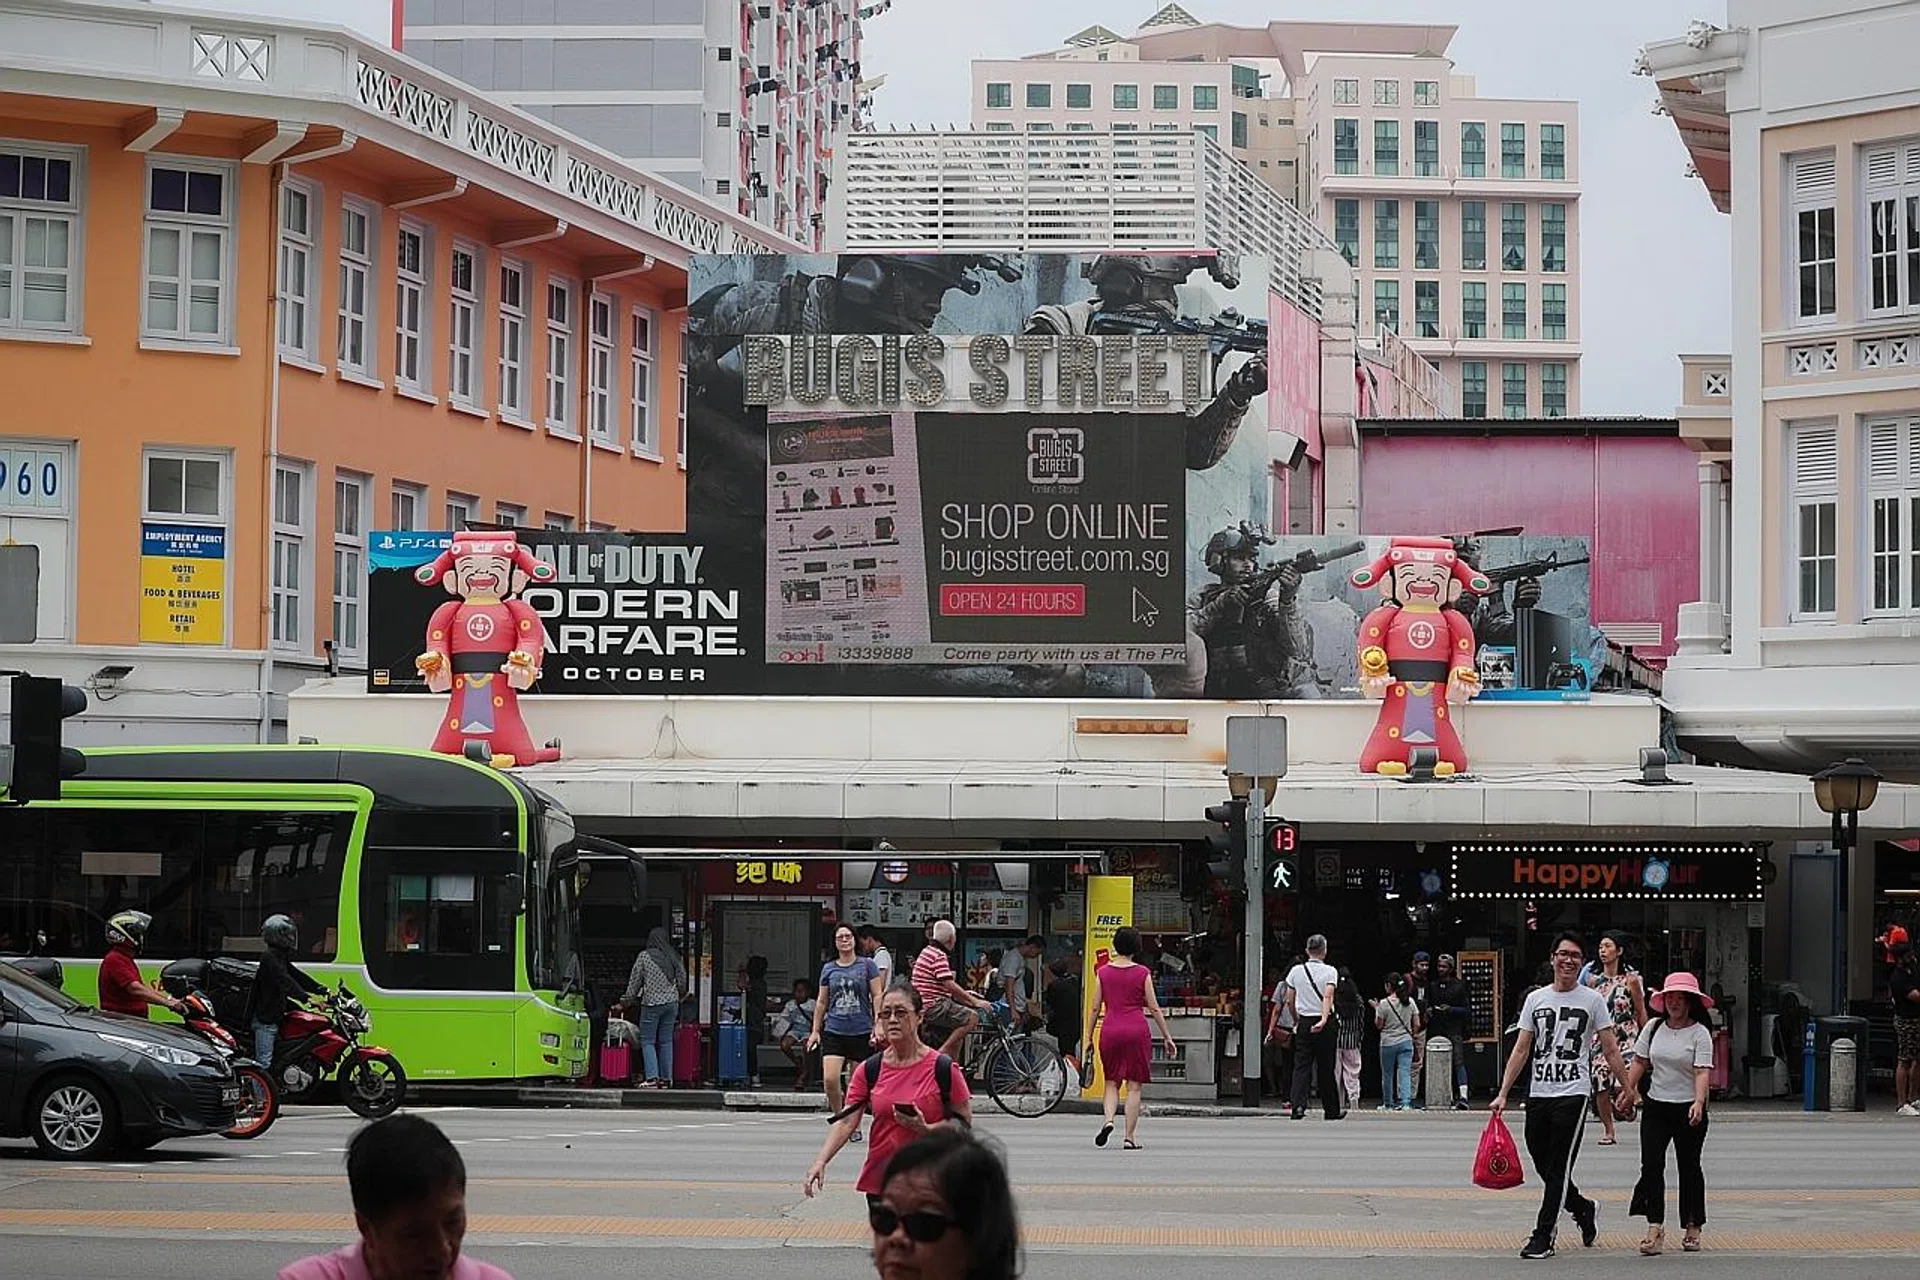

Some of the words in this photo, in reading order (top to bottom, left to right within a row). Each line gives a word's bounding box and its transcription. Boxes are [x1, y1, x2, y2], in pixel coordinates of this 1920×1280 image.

[745, 335, 946, 407] BUGIS
[969, 335, 1209, 407] STREET
[1039, 438, 1072, 457] BUGIS
[1040, 458, 1072, 472] STREET
[940, 503, 1035, 540] SHOP
[1046, 503, 1169, 540] ONLINE
[146, 532, 194, 541] EMPLOYMENT
[196, 535, 223, 543] AGENCY
[400, 538, 437, 549] PS4
[520, 544, 596, 584] ALL
[590, 553, 604, 568] OF
[940, 544, 1170, 577] bugisstreet.com.sg
[172, 565, 195, 574] HOTEL
[144, 588, 166, 597] FOOD
[168, 589, 175, 598] &
[177, 589, 220, 600] BEVERAGES
[949, 592, 992, 609] OPEN
[997, 592, 1016, 609] 24
[1022, 592, 1077, 609] HOURS
[522, 588, 739, 619] ODERN
[170, 614, 195, 623] RETAIL
[943, 648, 991, 660] Come
[996, 647, 1039, 663] party
[1042, 648, 1075, 660] with
[1080, 650, 1100, 660] us
[1104, 649, 1119, 660] at
[1125, 647, 1155, 660] The
[563, 667, 706, 681] OCTOBER
[1276, 828, 1295, 850] 13
[1096, 915, 1123, 925] FREE
